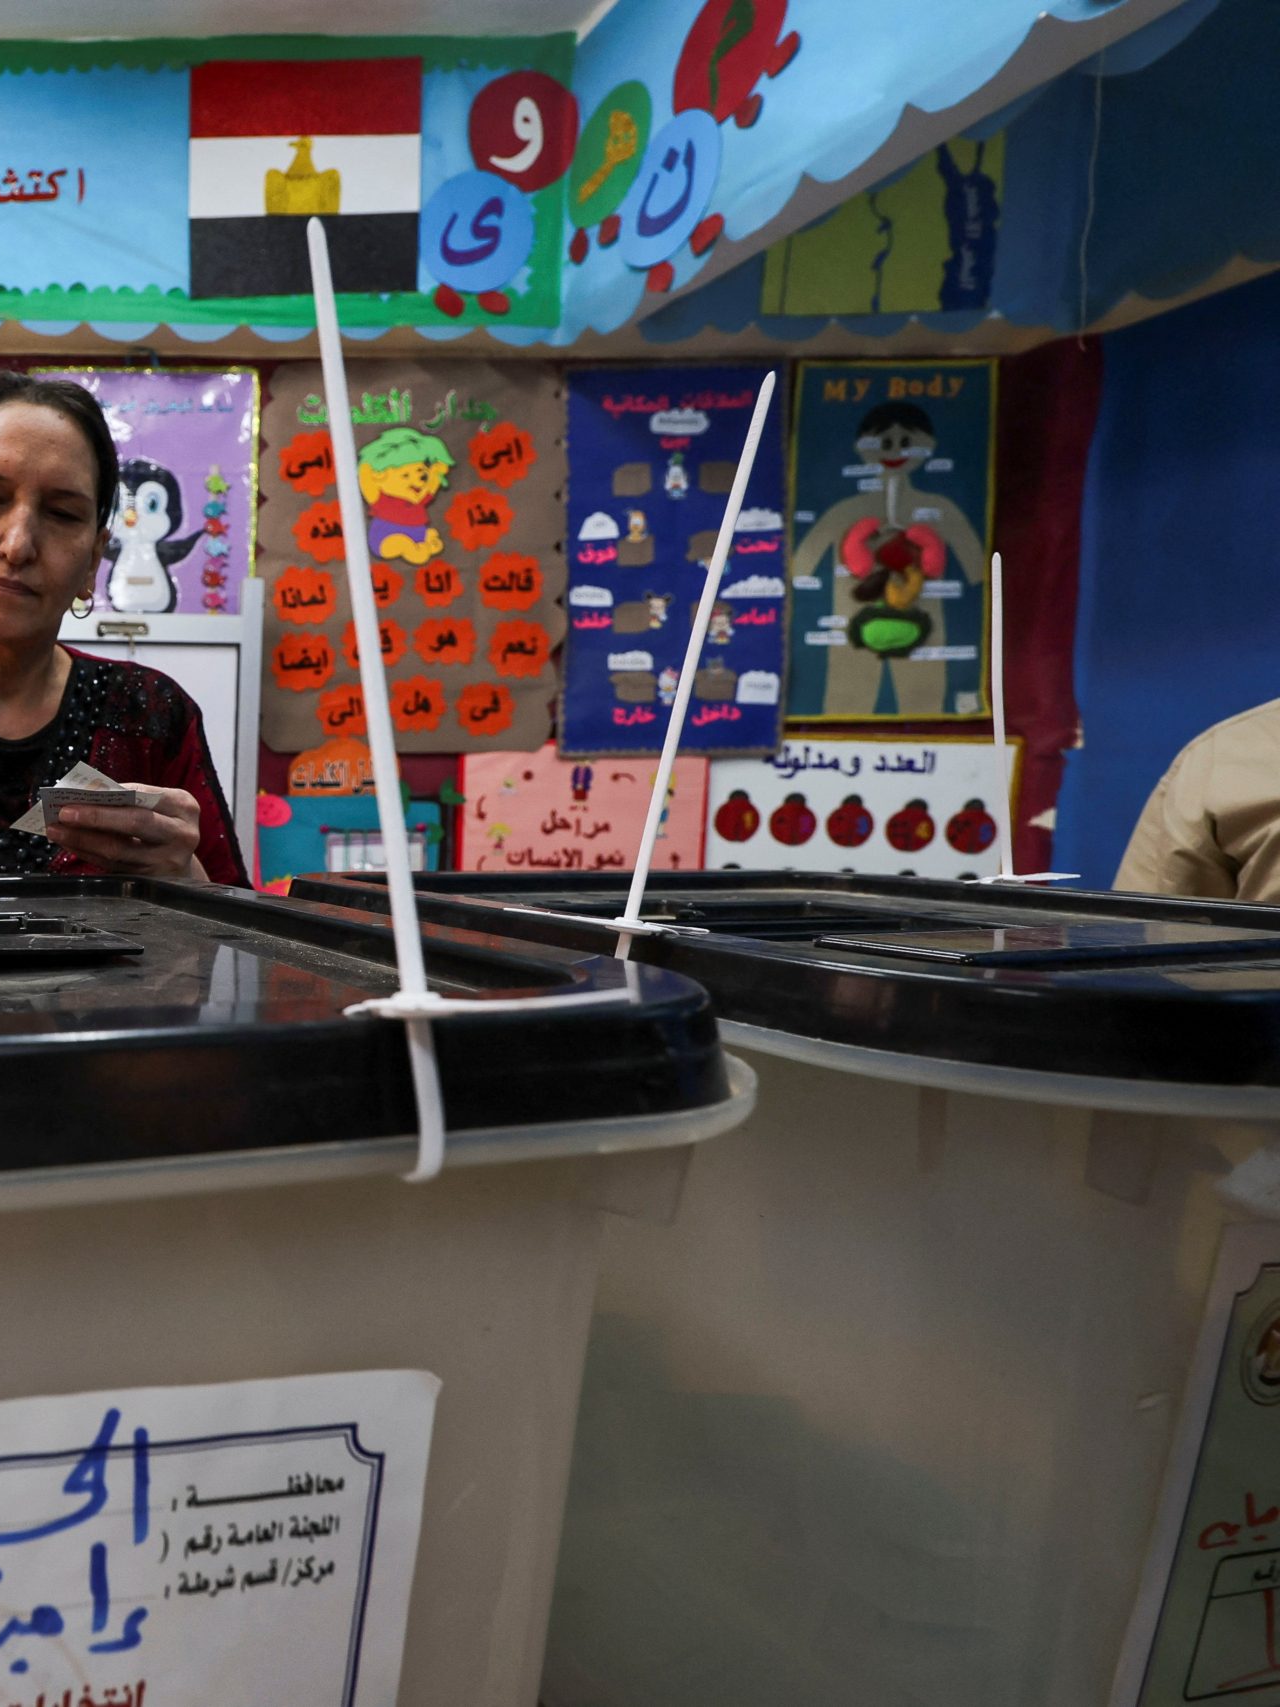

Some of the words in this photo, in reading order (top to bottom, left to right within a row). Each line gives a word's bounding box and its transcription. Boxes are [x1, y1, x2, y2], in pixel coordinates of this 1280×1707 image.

[489, 96, 544, 173] و
[636, 137, 696, 238] ن
[295, 387, 413, 425] الكلمت
[823, 379, 871, 403] My
[886, 376, 963, 401] Body
[873, 751, 937, 775] العدد
[539, 809, 613, 840] مراحل
[183, 1523, 223, 1561] رقم
[226, 1520, 285, 1547] العامة
[289, 1513, 342, 1545] اللجنة
[177, 1563, 236, 1598] شرطة
